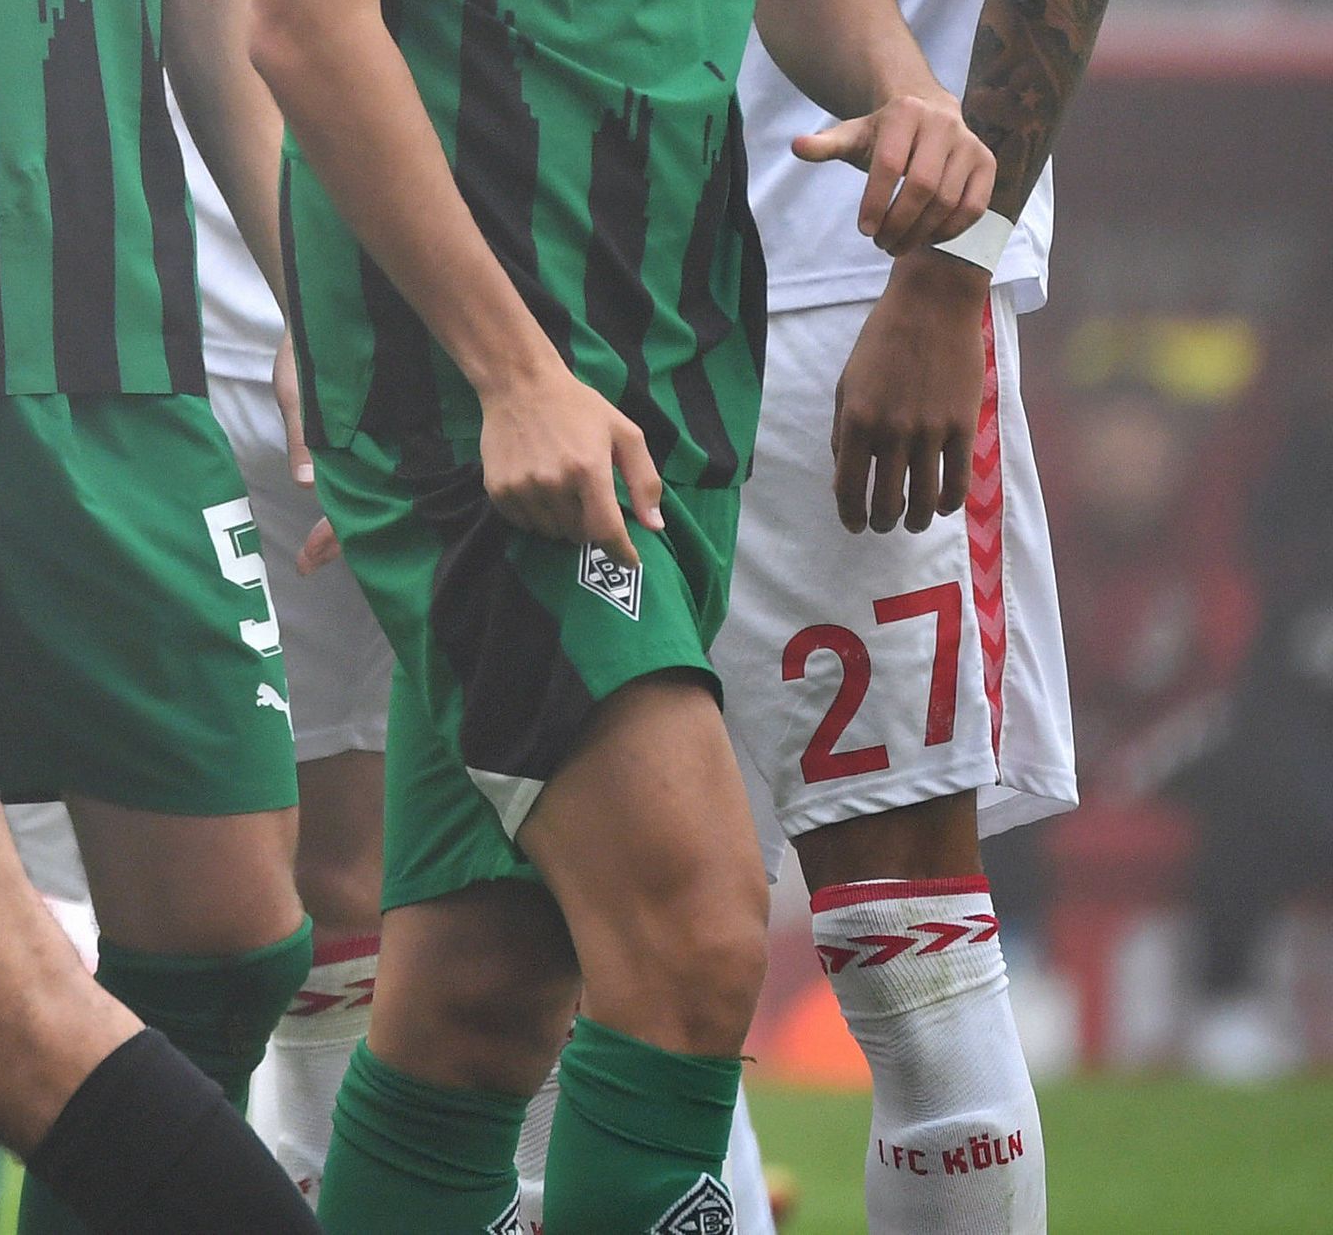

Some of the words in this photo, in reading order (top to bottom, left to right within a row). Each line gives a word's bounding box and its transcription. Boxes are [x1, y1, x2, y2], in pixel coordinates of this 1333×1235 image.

[202, 496, 283, 658] 5
[781, 580, 963, 784] 27
[941, 1130, 1023, 1175] KÖLN
